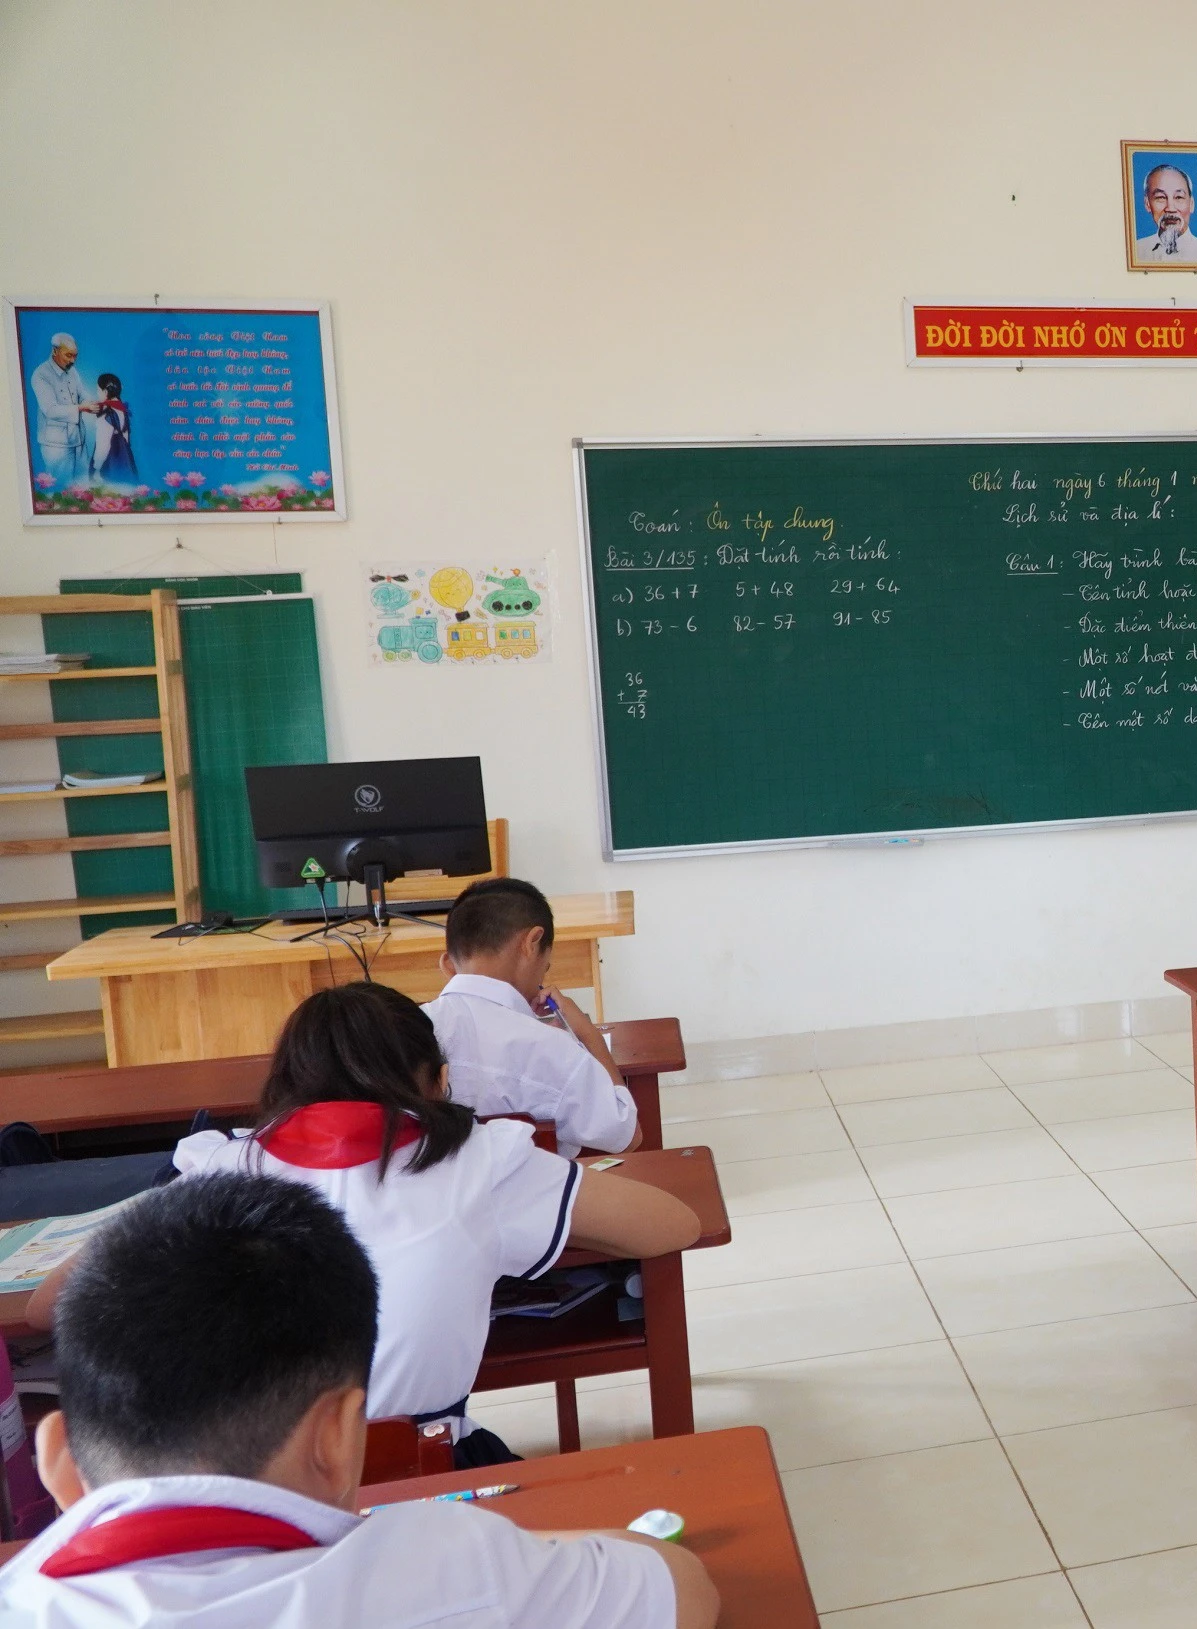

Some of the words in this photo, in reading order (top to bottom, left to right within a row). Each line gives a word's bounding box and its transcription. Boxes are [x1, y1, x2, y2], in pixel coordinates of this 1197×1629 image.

[926, 320, 971, 348] ĐỜI
[981, 320, 1025, 348] ĐỜI
[1034, 320, 1085, 348] NHỚ
[1095, 325, 1127, 348] ƠN
[1135, 318, 1184, 348] CHỦ
[969, 468, 1002, 491] Thứ
[1010, 470, 1037, 490] hai
[1053, 472, 1092, 500] ngày
[1098, 473, 1105, 487] 6
[1117, 468, 1160, 497] tháng
[1171, 471, 1177, 486] 1
[707, 501, 731, 530] Ôn
[741, 510, 774, 541] tập
[1002, 503, 1039, 528] Lịch
[1047, 501, 1068, 522] sử
[1080, 507, 1099, 521] và
[1111, 504, 1139, 526] địa
[604, 545, 634, 568] Bài
[716, 543, 749, 570] Đặt
[755, 540, 800, 563] tính
[1006, 552, 1041, 571] Câu
[1072, 550, 1113, 579] Hãy
[1120, 548, 1163, 569] trình
[612, 587, 633, 603] a)
[644, 585, 665, 601] 36
[688, 584, 699, 598] 7
[736, 581, 745, 597] 5
[770, 581, 794, 597] 48
[830, 580, 852, 593] 29
[875, 577, 901, 594] 64
[1079, 583, 1110, 601] Tên
[1113, 578, 1150, 599] tỉnh
[1158, 580, 1196, 602] hoặc
[617, 619, 631, 636] b)
[641, 620, 662, 635] 73
[686, 616, 697, 631] 6
[734, 616, 755, 631] 82
[774, 614, 797, 630] 57
[833, 612, 850, 626] 91
[872, 609, 891, 624] 85
[1079, 611, 1106, 638] Đặc
[1114, 610, 1152, 632] điểm
[1158, 612, 1197, 630] thiên
[1079, 647, 1108, 670] Một
[1115, 646, 1131, 664] số
[1138, 643, 1175, 666] hoạt
[626, 672, 643, 686] 36
[1080, 677, 1112, 704] Một
[1121, 676, 1143, 696] số
[637, 690, 647, 701] 7
[627, 704, 645, 719] 43
[1078, 712, 1109, 729] Tên
[1116, 710, 1145, 732] một
[1154, 707, 1173, 724] số
